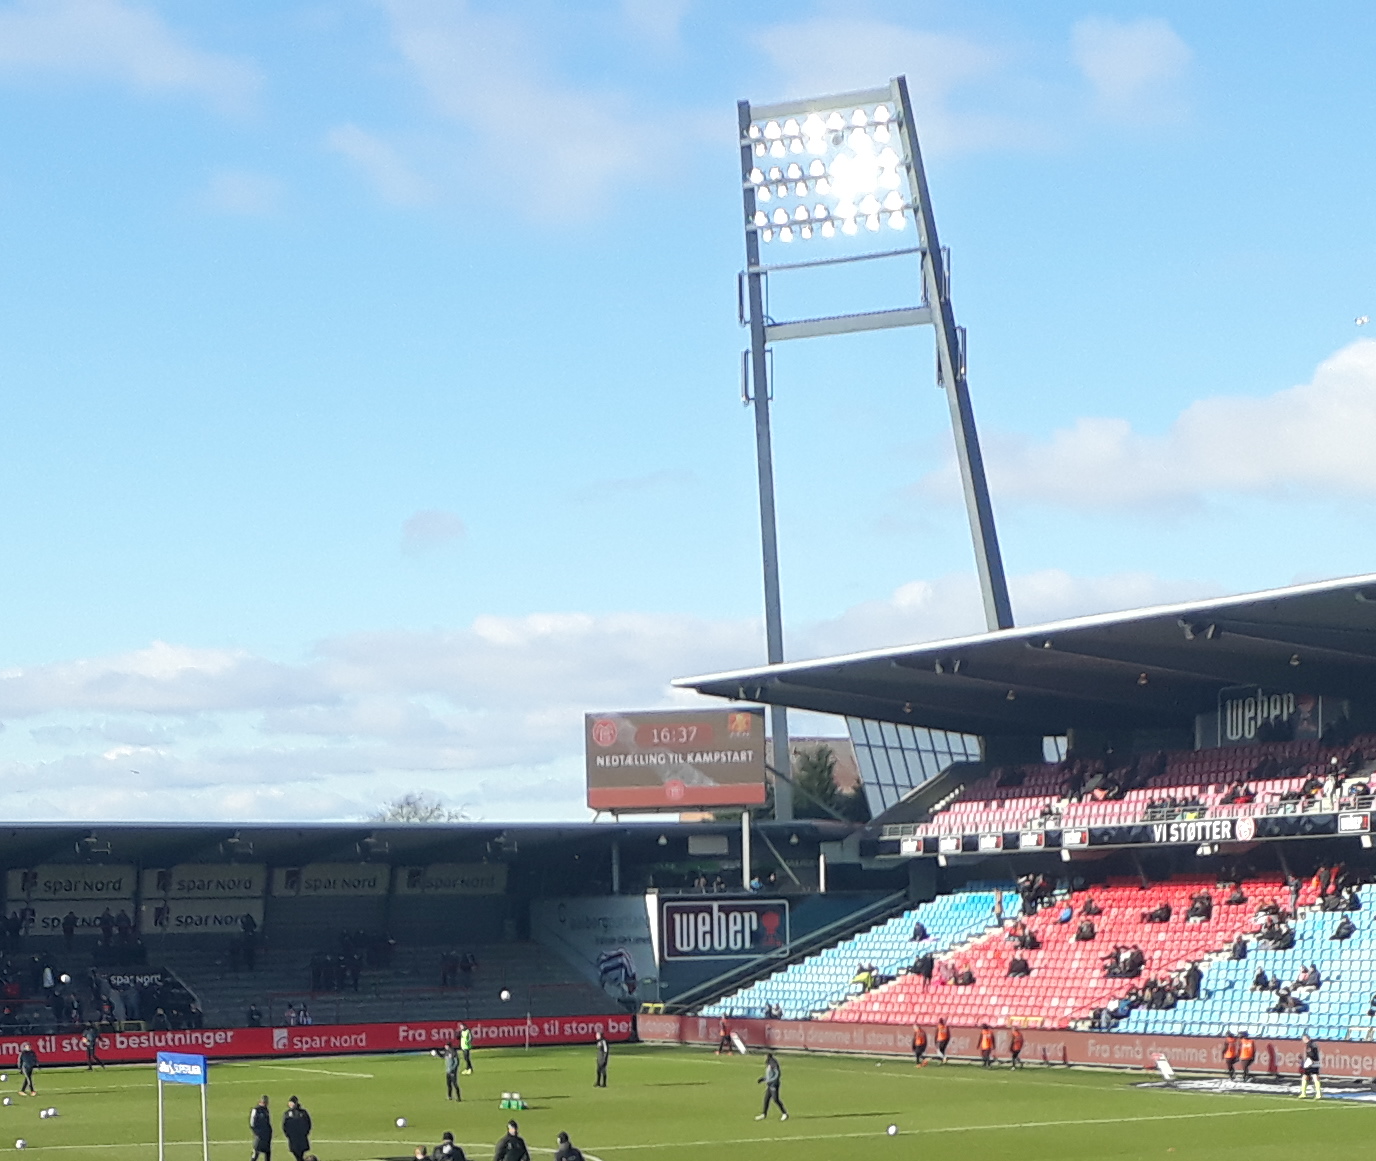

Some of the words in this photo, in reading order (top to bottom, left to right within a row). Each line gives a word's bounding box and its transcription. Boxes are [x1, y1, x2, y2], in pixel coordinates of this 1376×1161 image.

[651, 725, 698, 744] 16:37
[596, 752, 667, 767] NEDTÆLLING
[669, 752, 684, 764] TIL
[686, 750, 754, 764] KAMPSTART
[1154, 823, 1167, 842] VI
[1170, 820, 1232, 842] STØTTER
[43, 880, 79, 895] spar
[177, 878, 213, 893] spar
[304, 878, 337, 890] spar
[176, 915, 211, 930] spar
[673, 900, 758, 951] weber
[399, 1026, 425, 1041] Fra
[471, 1021, 539, 1039] drømme
[543, 1018, 559, 1035] til
[563, 1019, 604, 1034] store
[37, 1036, 56, 1053] til
[115, 1030, 234, 1049] beslutninger
[292, 1035, 326, 1050] spar
[330, 1031, 366, 1048] Nord
[1087, 1039, 1112, 1057] Fra
[1115, 1039, 1142, 1059] små
